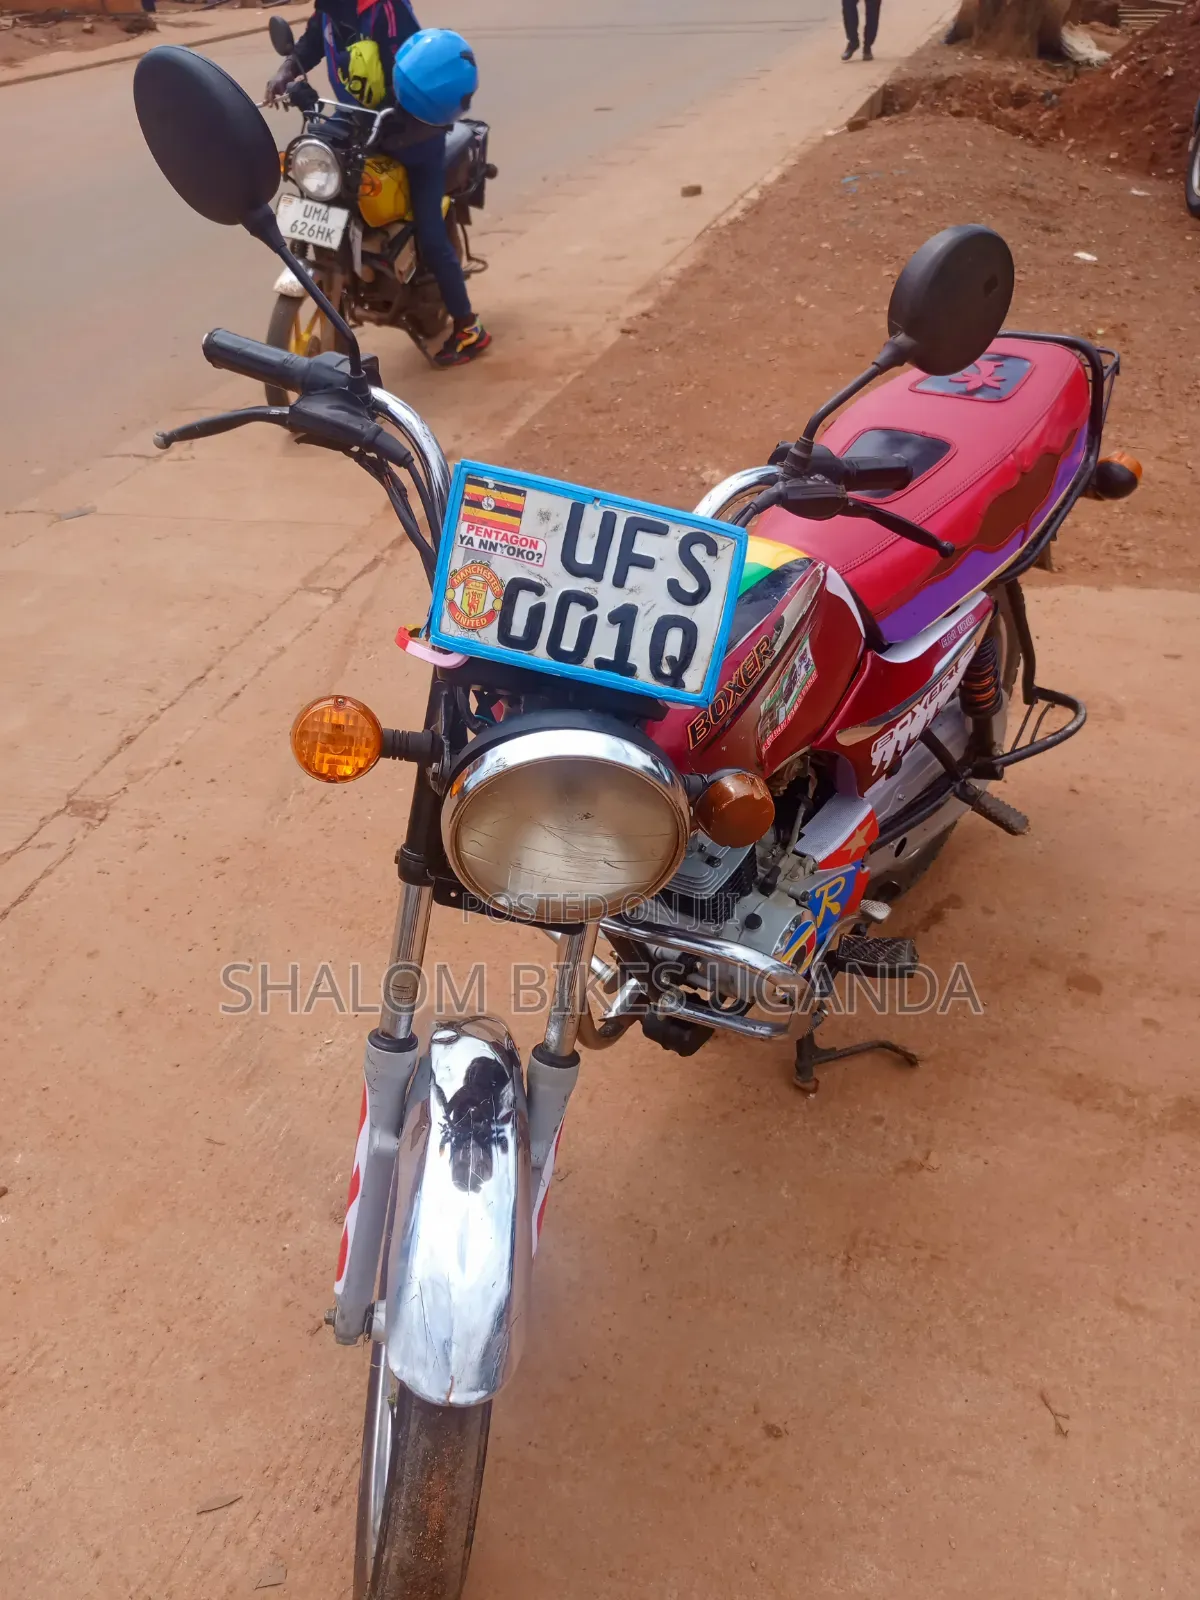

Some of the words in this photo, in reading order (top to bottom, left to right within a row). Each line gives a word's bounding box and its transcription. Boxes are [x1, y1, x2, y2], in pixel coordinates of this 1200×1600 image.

[303, 204, 329, 224] UMA
[290, 220, 335, 244] 626HK
[459, 534, 474, 547] YA
[478, 539, 543, 563] NNYOKO?
[466, 524, 538, 550] PENTAGON
[560, 501, 718, 606] UFS
[454, 565, 500, 594] MANCHESTER
[455, 612, 487, 627] UNITED
[687, 634, 775, 750] BOXER
